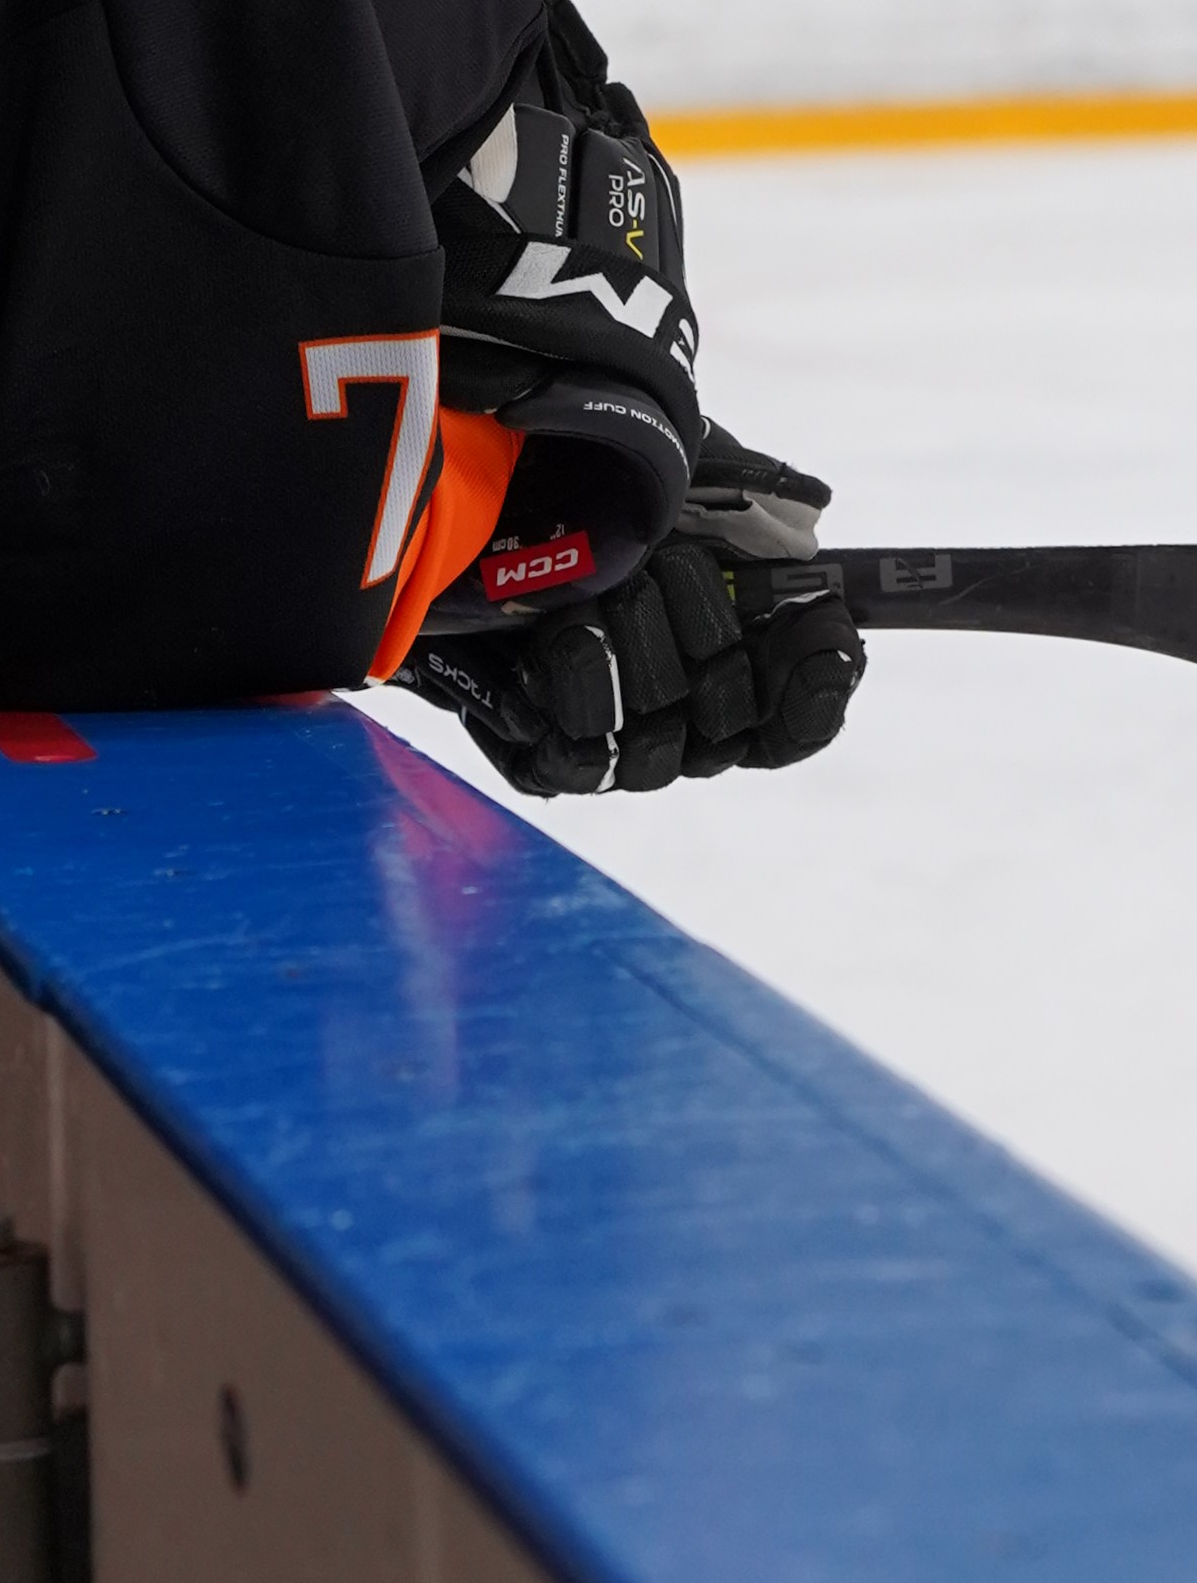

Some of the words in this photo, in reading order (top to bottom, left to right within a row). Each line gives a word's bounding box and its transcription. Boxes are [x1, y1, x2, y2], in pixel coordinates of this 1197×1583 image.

[558, 133, 570, 166] PRO
[609, 174, 624, 228] PRO
[623, 158, 645, 260] AS-V
[583, 400, 627, 415] CUFF
[495, 547, 579, 587] CCM
[428, 652, 494, 709] TACKS
